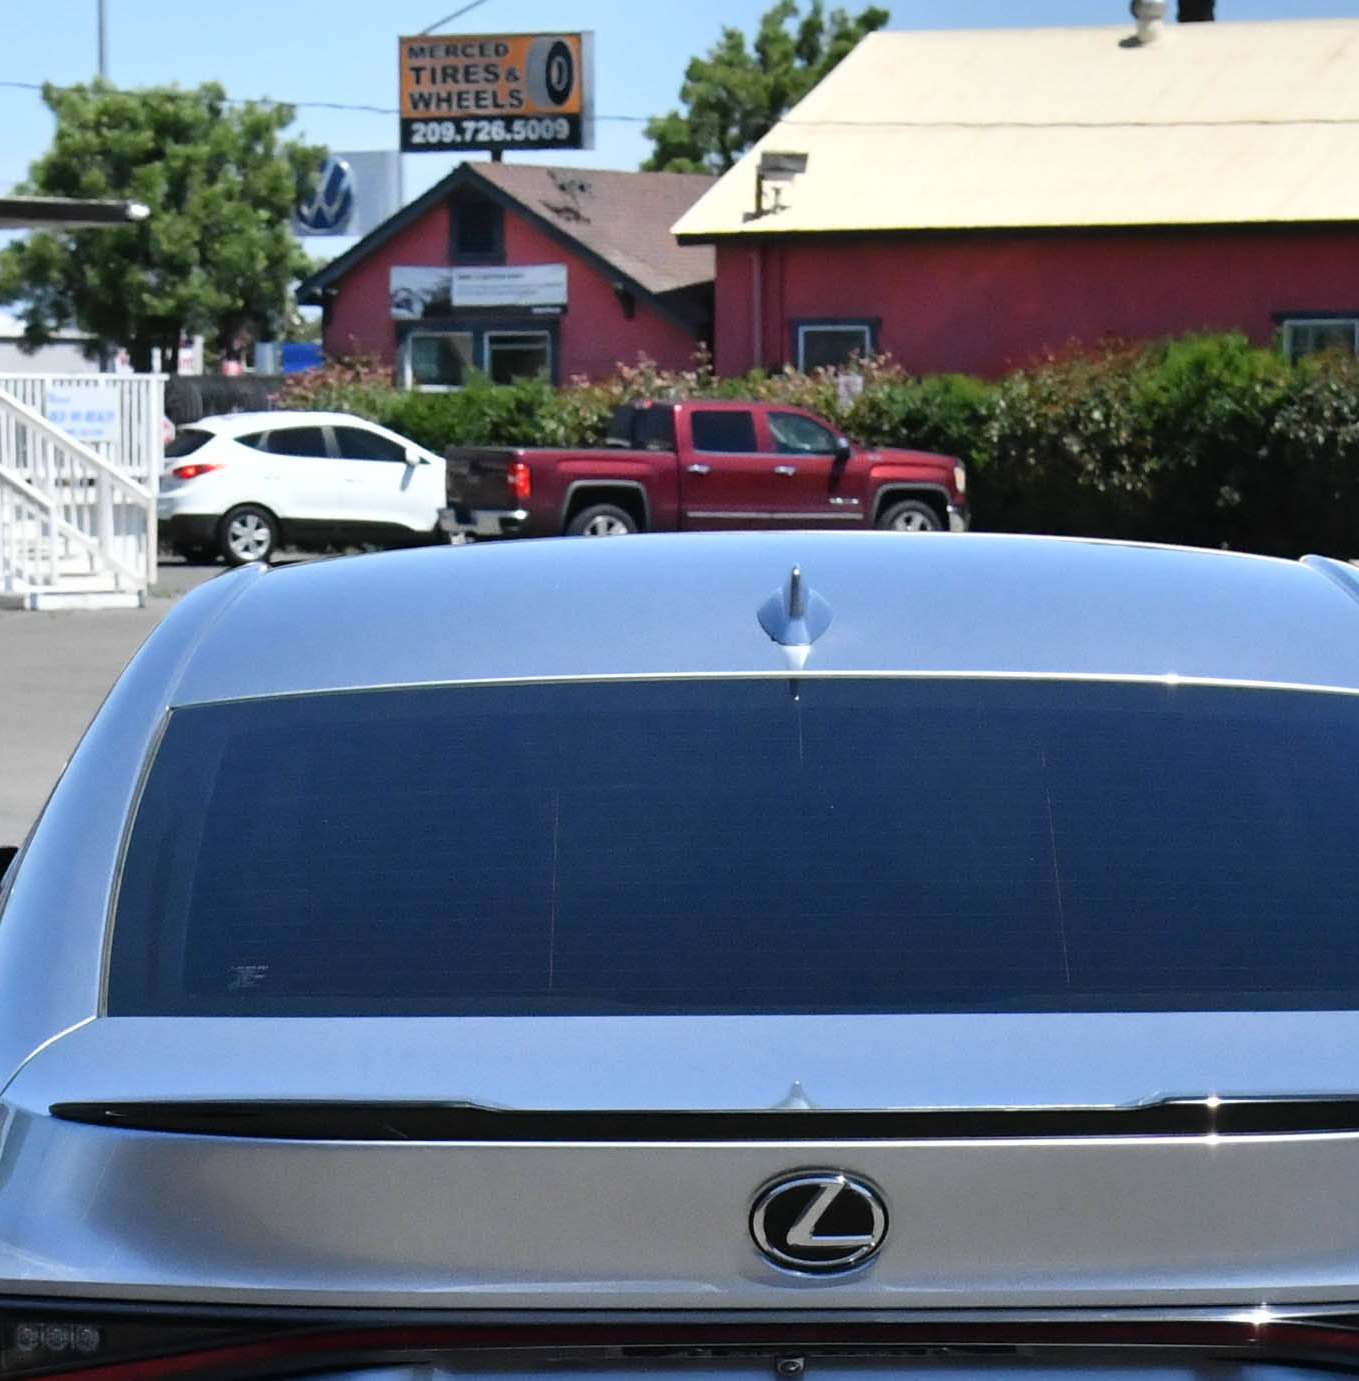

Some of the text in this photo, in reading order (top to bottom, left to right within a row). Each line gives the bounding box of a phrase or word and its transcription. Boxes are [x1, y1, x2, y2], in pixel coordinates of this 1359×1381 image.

[408, 42, 510, 60] MERCED
[409, 64, 521, 85] TIRES &
[409, 88, 524, 111] WHEELS
